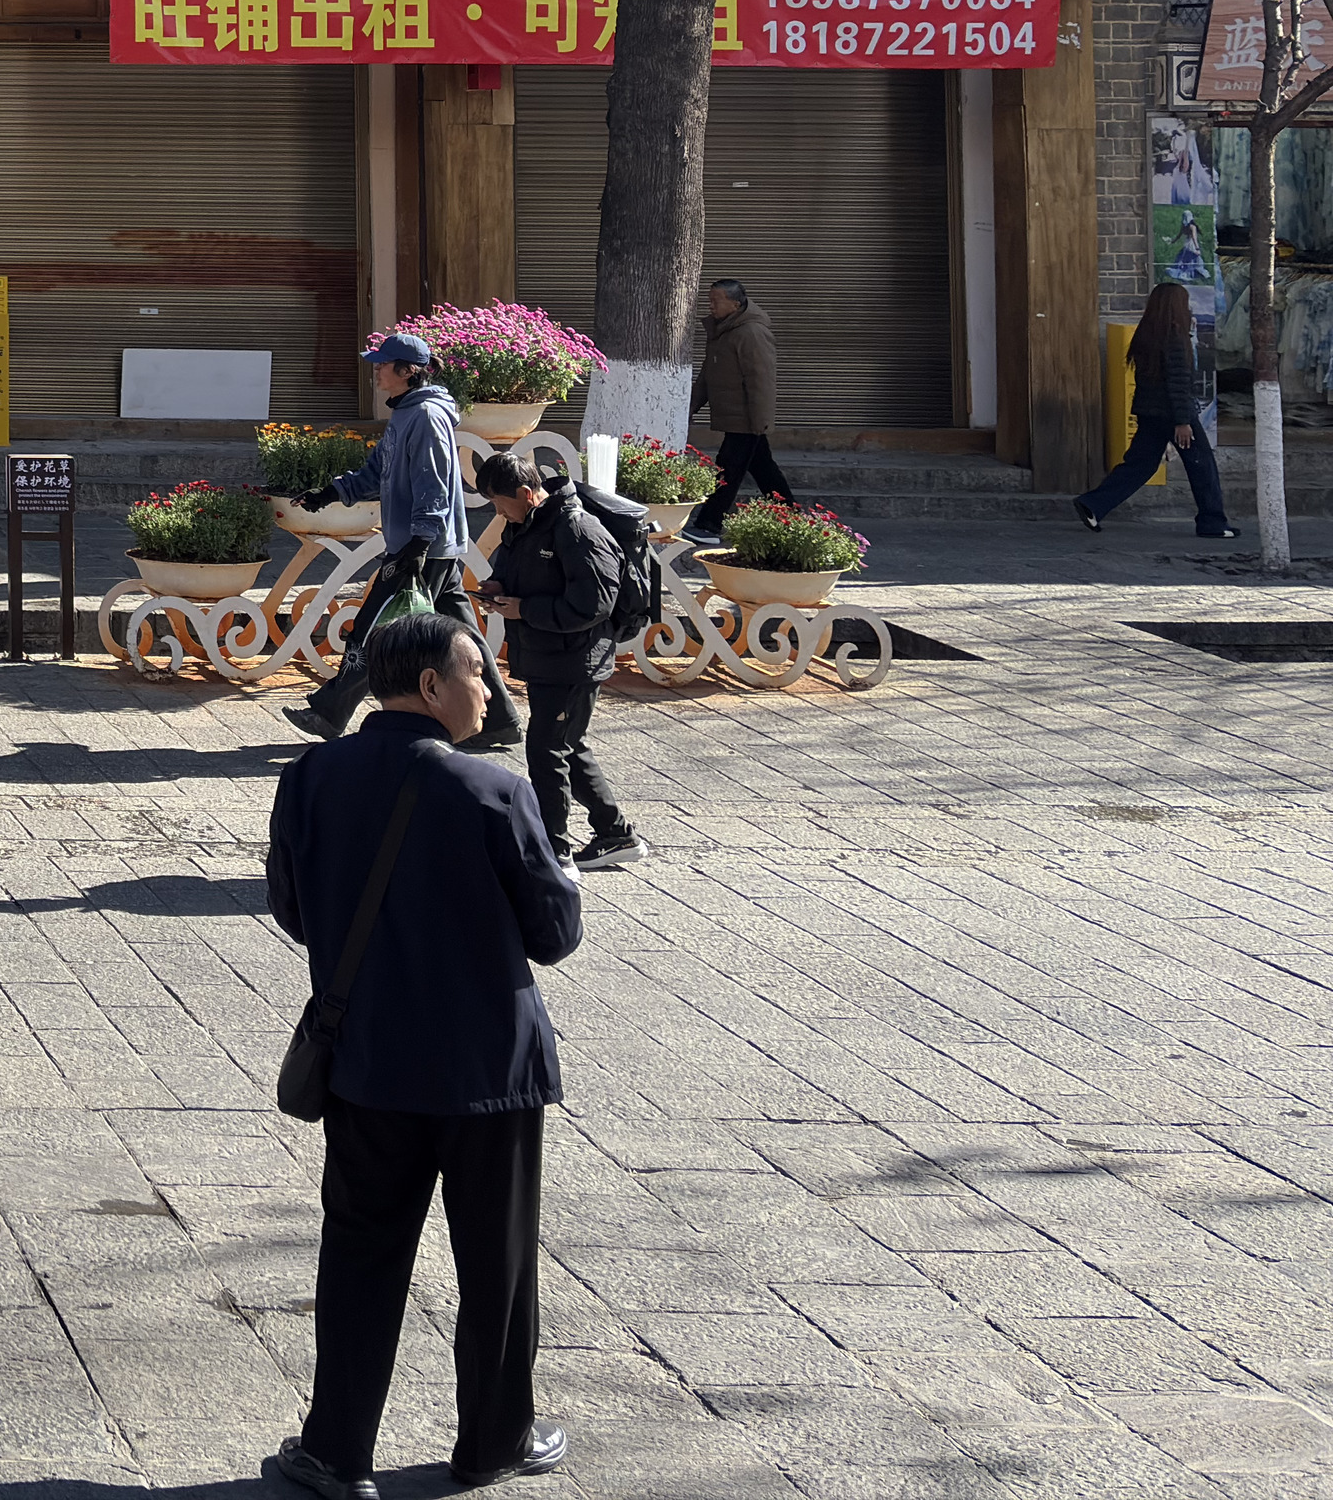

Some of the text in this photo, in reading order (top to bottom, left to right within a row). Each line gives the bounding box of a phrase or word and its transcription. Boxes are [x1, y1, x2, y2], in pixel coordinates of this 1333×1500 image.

[762, 19, 1038, 57] 18187221504
[1214, 81, 1262, 91] LANTI
[15, 459, 71, 473] 爱护花草
[14, 474, 72, 488] 保护环境
